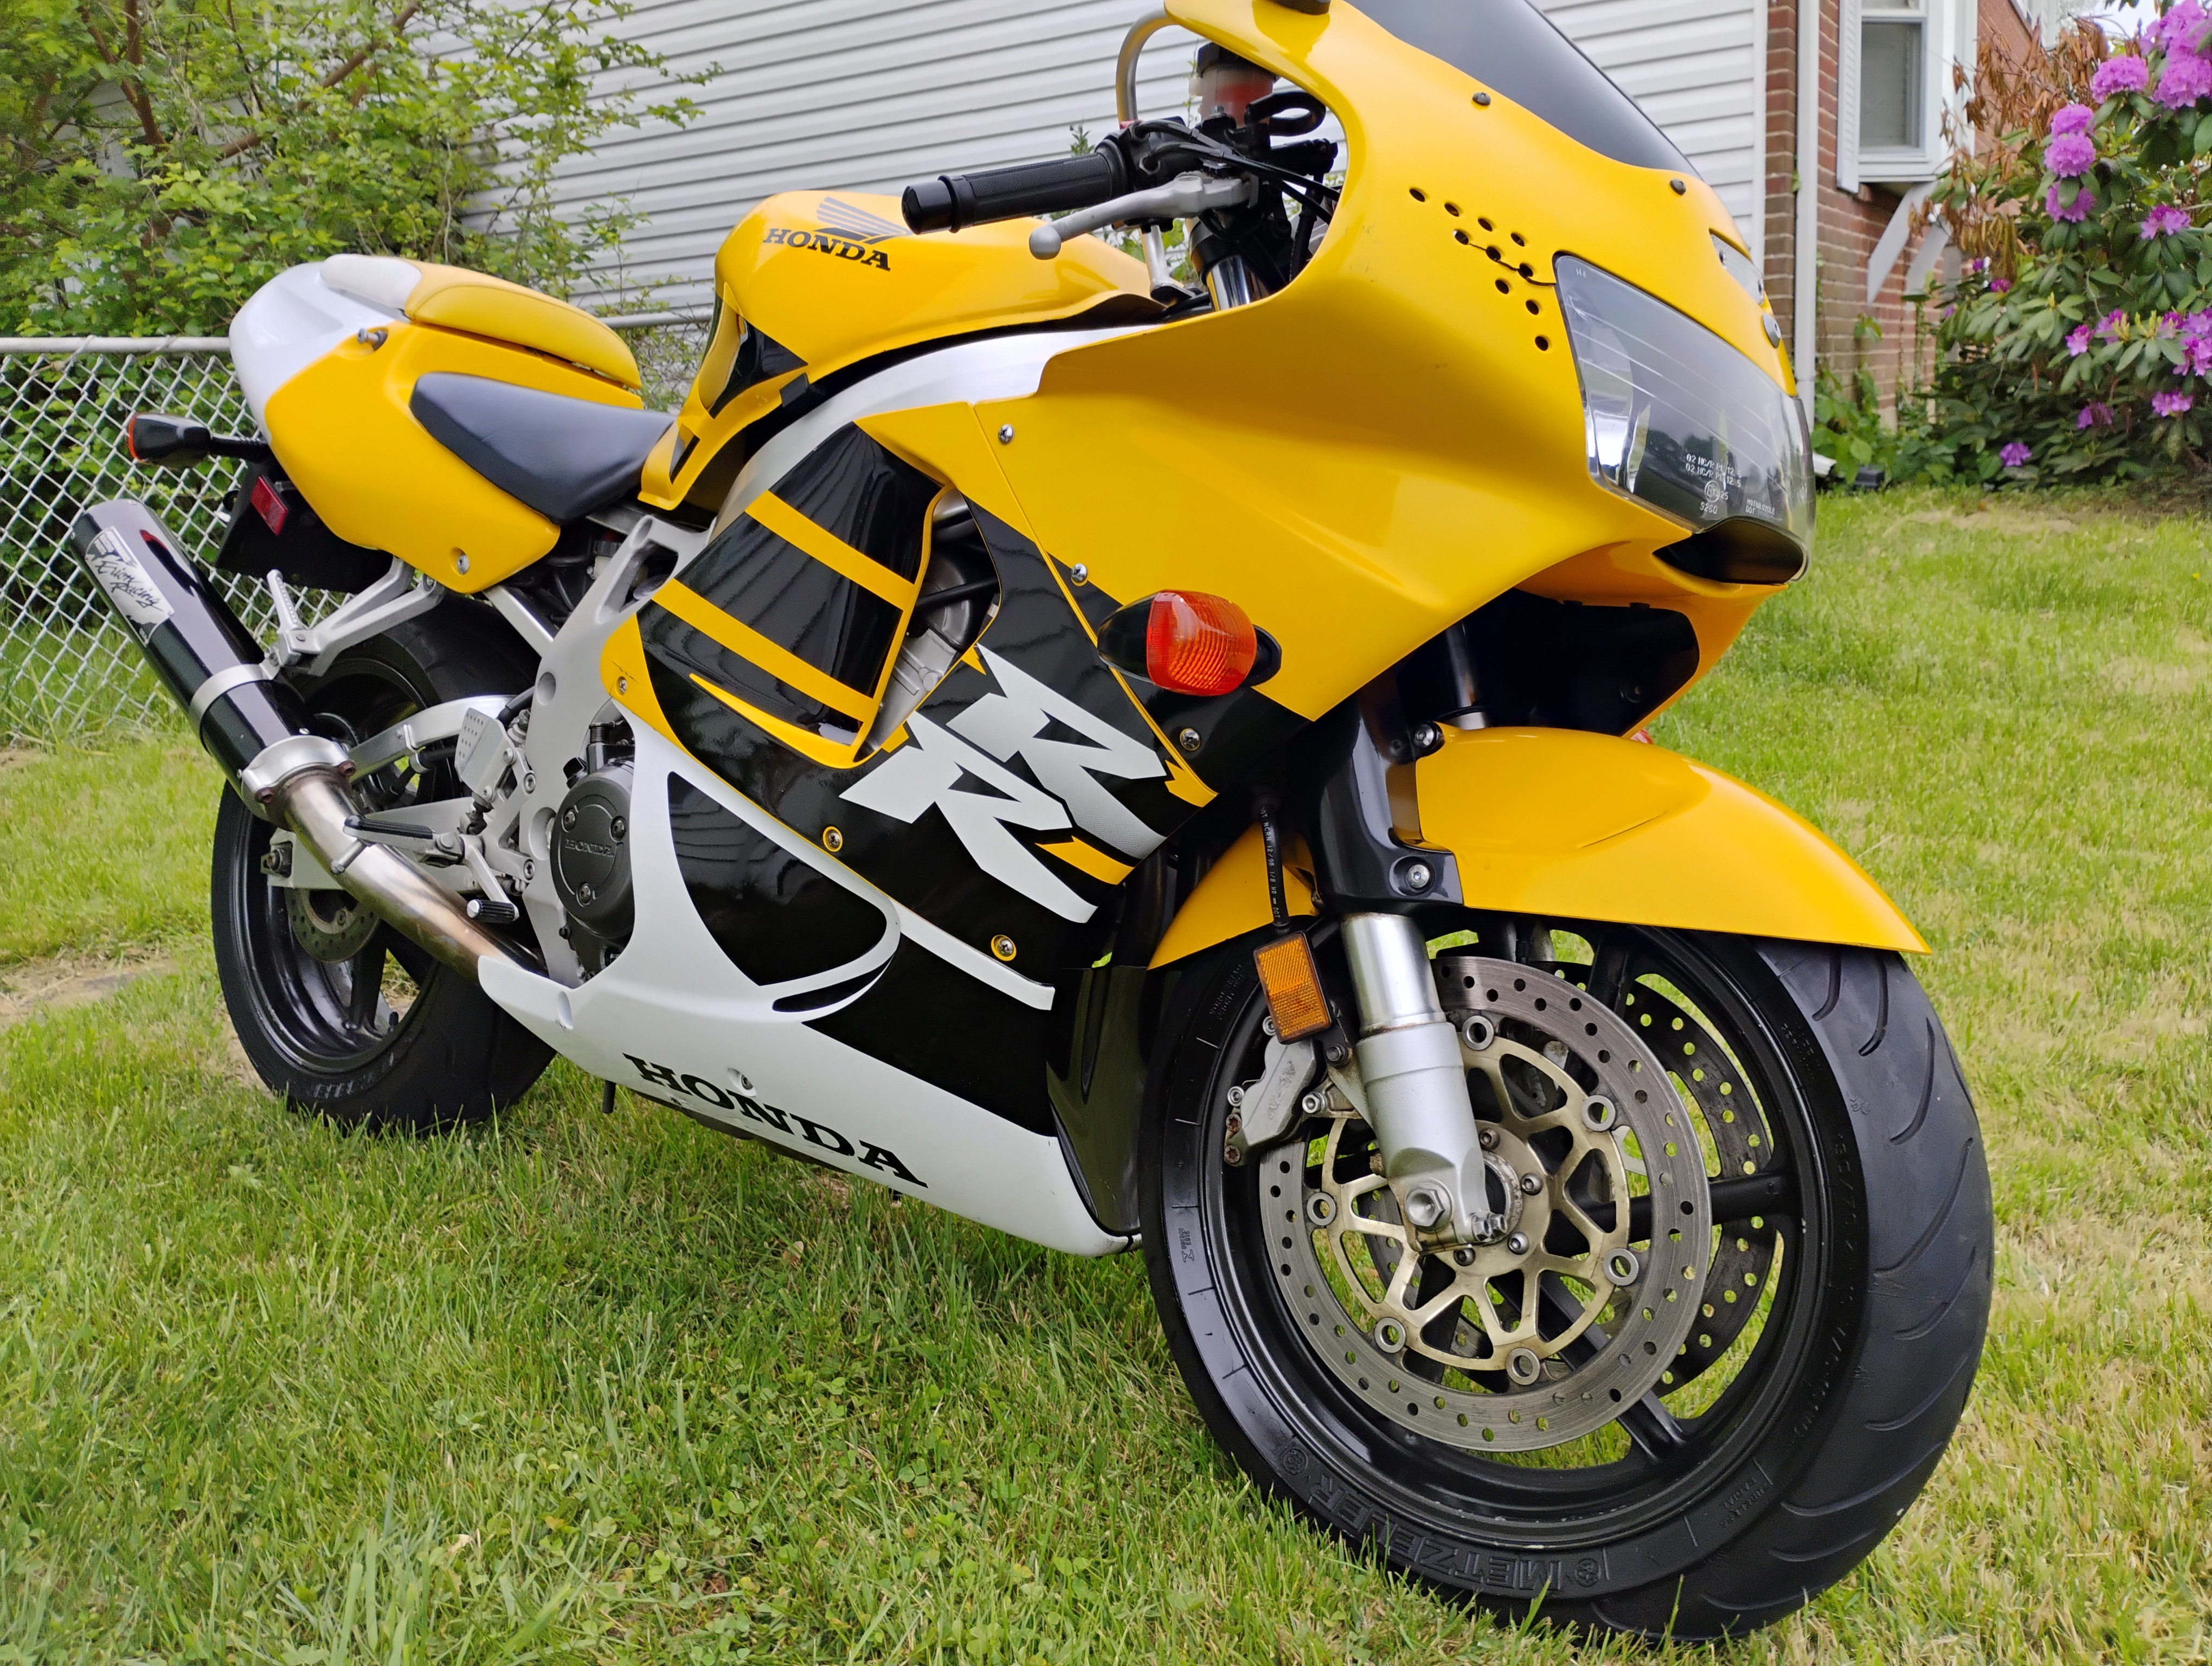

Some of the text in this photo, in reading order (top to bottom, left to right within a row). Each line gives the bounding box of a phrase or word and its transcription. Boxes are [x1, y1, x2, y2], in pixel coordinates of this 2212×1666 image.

[763, 228, 891, 272] HONDA
[1685, 463, 1695, 473] 02
[1697, 466, 1713, 478] HC/R
[1686, 453, 1696, 464] 02
[1698, 456, 1714, 469] HC/R
[1720, 490, 1728, 500] 25
[1700, 502, 1718, 514] 9260
[1745, 505, 1756, 514] DOT
[110, 581, 163, 611] Racing
[1263, 822, 1271, 841] NCRN
[565, 838, 614, 857] HONDA
[1266, 845, 1275, 866] 12/98
[622, 1052, 929, 1188] HONDA
[1309, 1473, 1561, 1591] METZELER
